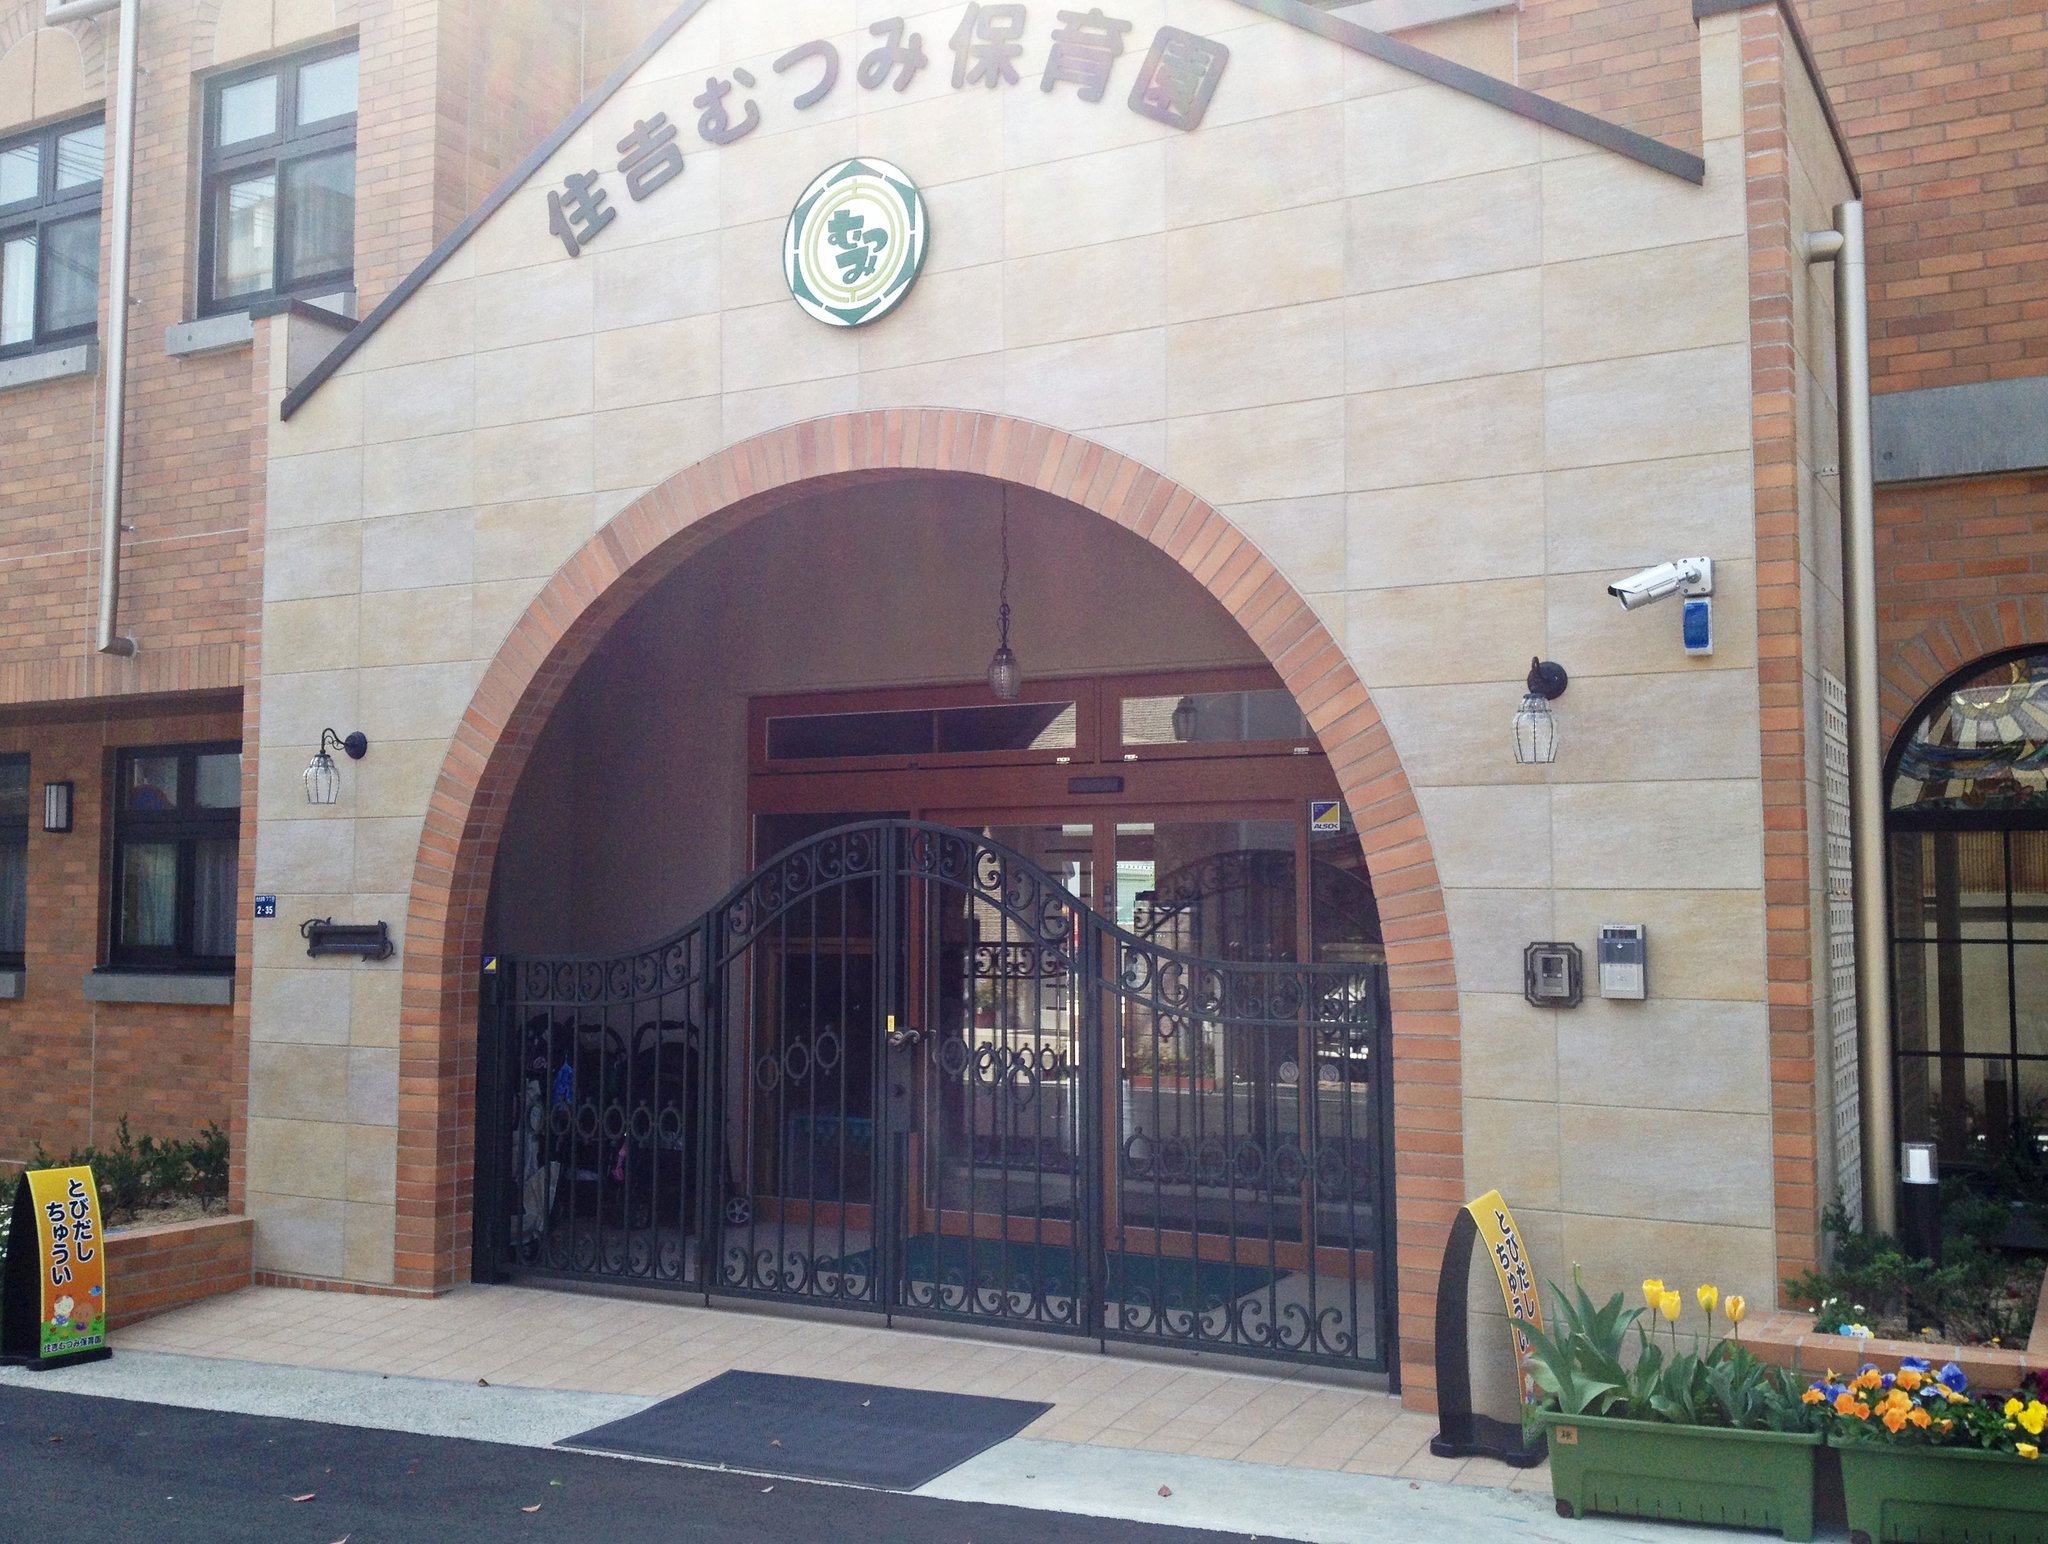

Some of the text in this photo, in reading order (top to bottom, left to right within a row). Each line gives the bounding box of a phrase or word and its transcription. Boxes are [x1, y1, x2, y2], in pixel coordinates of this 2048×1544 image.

[547, 2, 1231, 257] 住吉むつみ保育園
[827, 209, 889, 284] むつみ
[46, 1201, 72, 1286] ちゅうい
[67, 1178, 94, 1263] とびだし
[1494, 1209, 1535, 1319] とびだし
